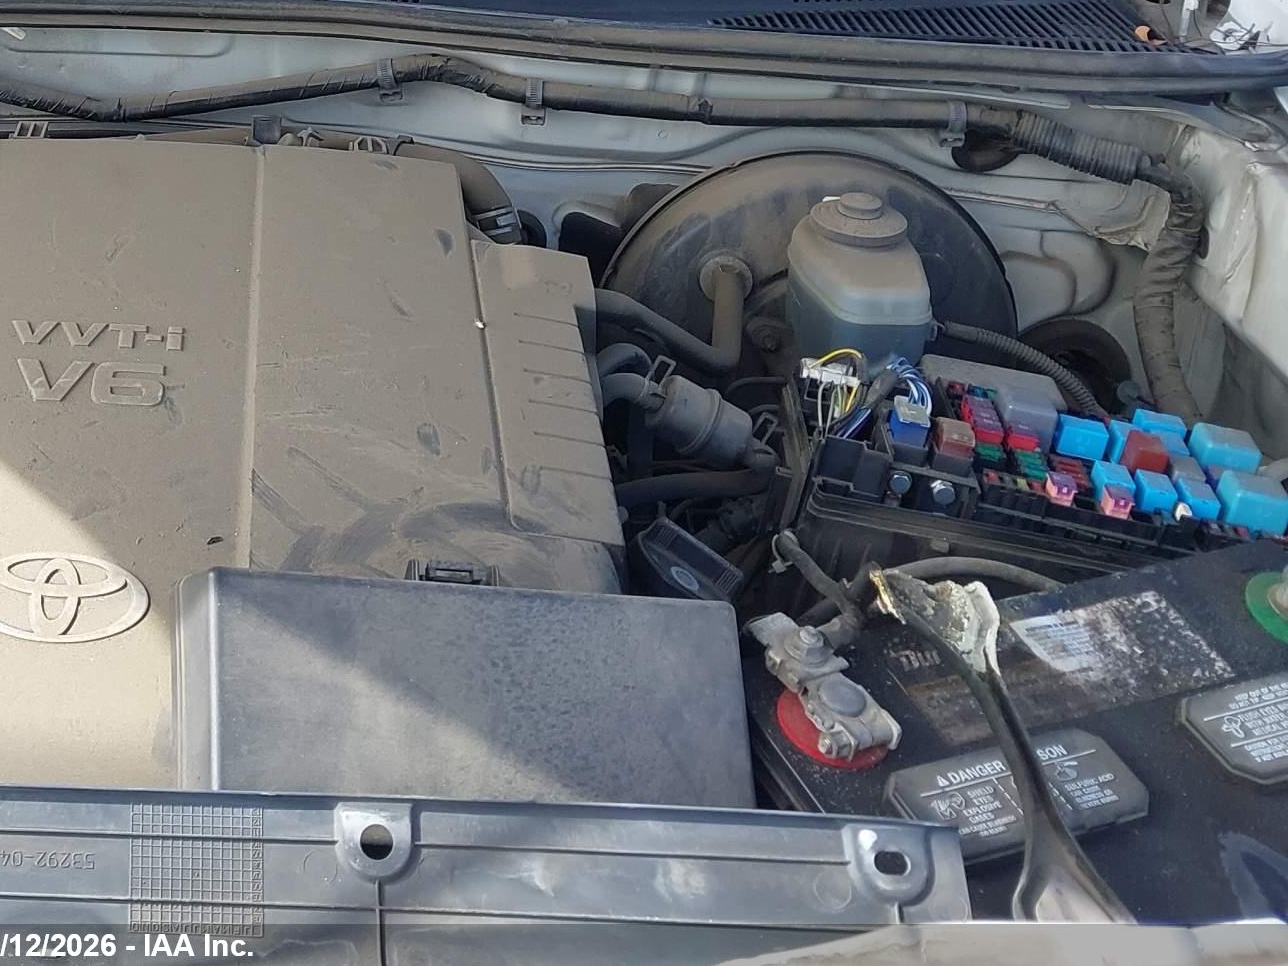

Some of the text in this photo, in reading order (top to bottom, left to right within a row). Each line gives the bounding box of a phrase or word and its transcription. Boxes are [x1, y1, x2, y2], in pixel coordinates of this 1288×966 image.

[12, 319, 185, 352] VVT-i
[16, 358, 167, 408] V6
[946, 744, 1068, 785] DANGER SON
